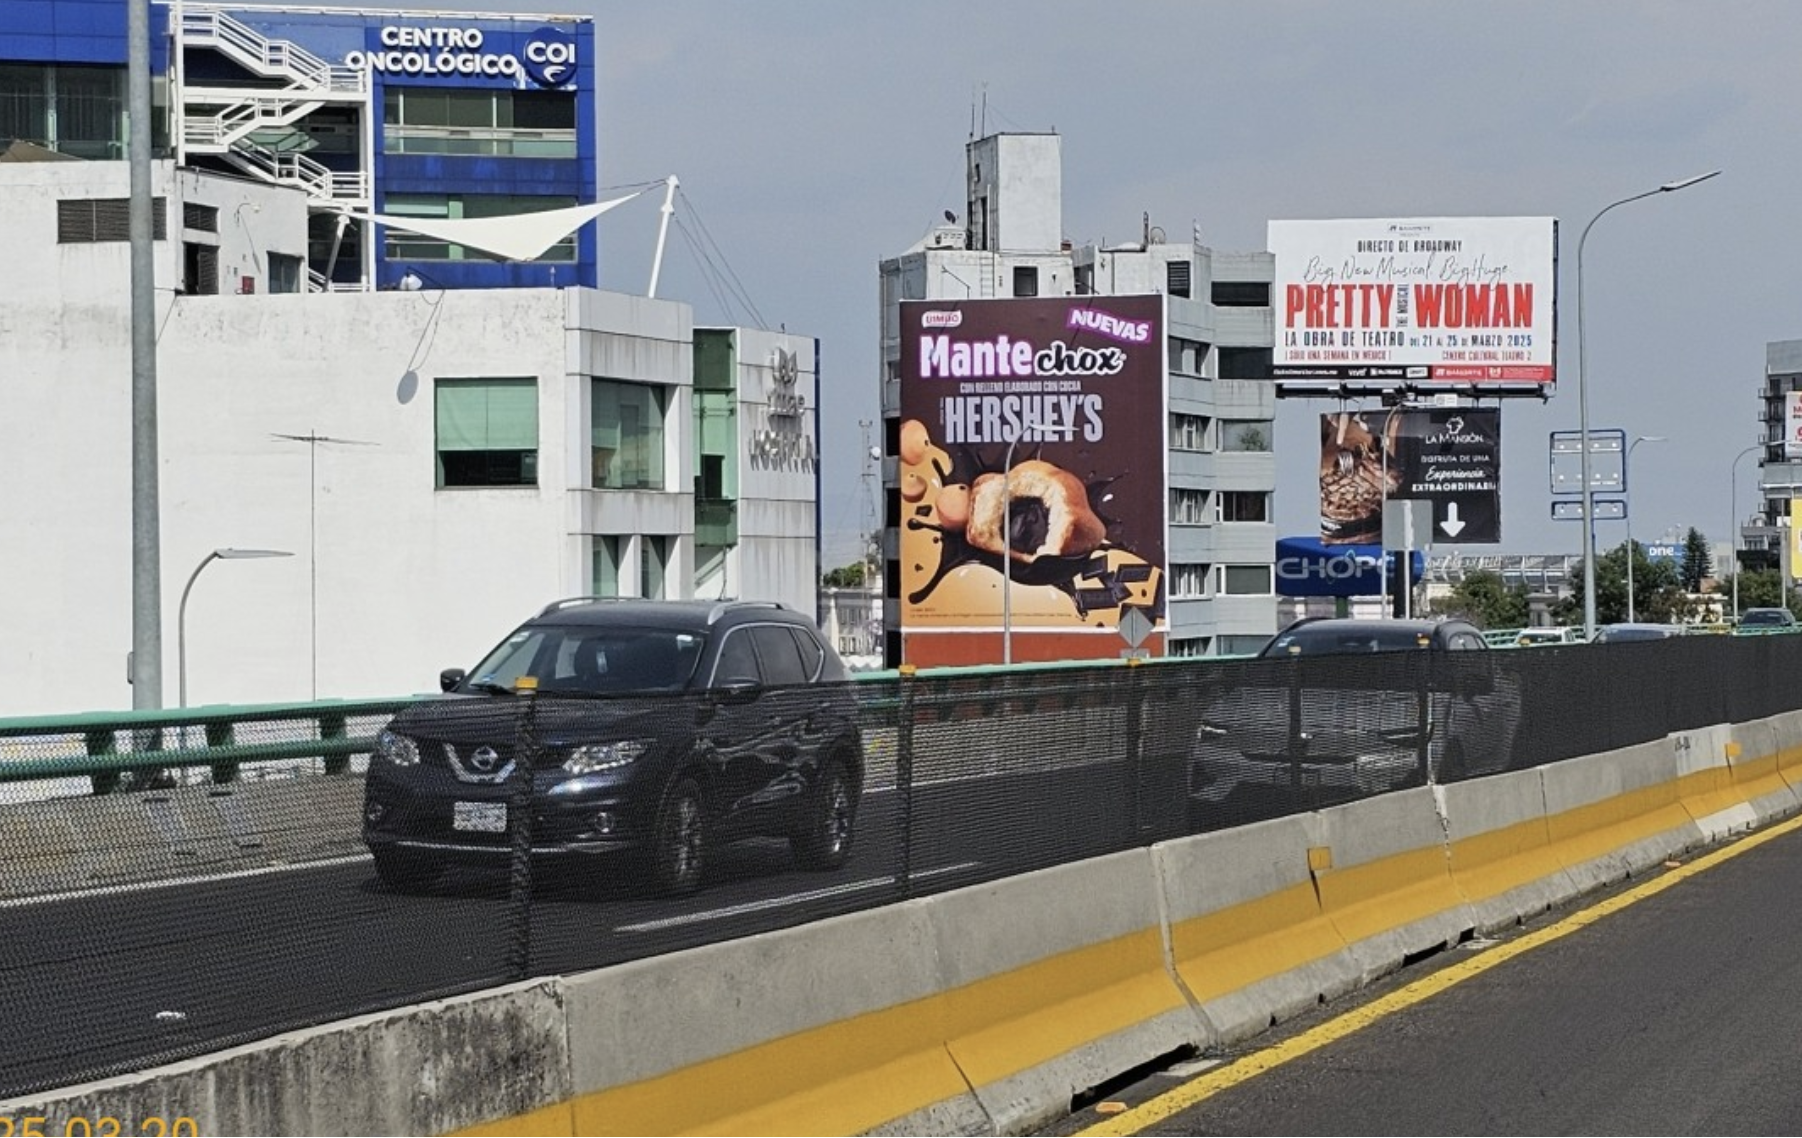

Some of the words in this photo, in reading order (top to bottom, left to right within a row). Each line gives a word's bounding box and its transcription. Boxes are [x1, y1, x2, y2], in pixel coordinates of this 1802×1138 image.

[381, 26, 483, 48] CENTRO
[345, 47, 519, 75] ONCOLÓGICO
[527, 41, 575, 63] COI
[1358, 240, 1394, 252] DIRECTO
[1399, 240, 1408, 252] DE
[1414, 240, 1462, 252] BROADWAY
[1304, 256, 1336, 293] Big
[1340, 255, 1373, 280] New
[1285, 284, 1394, 328] PRETTY
[1414, 284, 1534, 328] WOMAN
[1070, 309, 1149, 341] NUEVAS
[1285, 332, 1297, 346] LA
[1304, 332, 1334, 346] OBRA
[1342, 332, 1355, 346] DE
[1362, 331, 1405, 346] TEATRO
[1422, 335, 1432, 346] 21
[1447, 335, 1457, 346] 25
[1471, 335, 1502, 346] MARZO
[1507, 335, 1532, 346] 2025
[945, 394, 1103, 443] HERSHEY'S
[1426, 435, 1437, 444] LA
[1649, 546, 1674, 556] one
